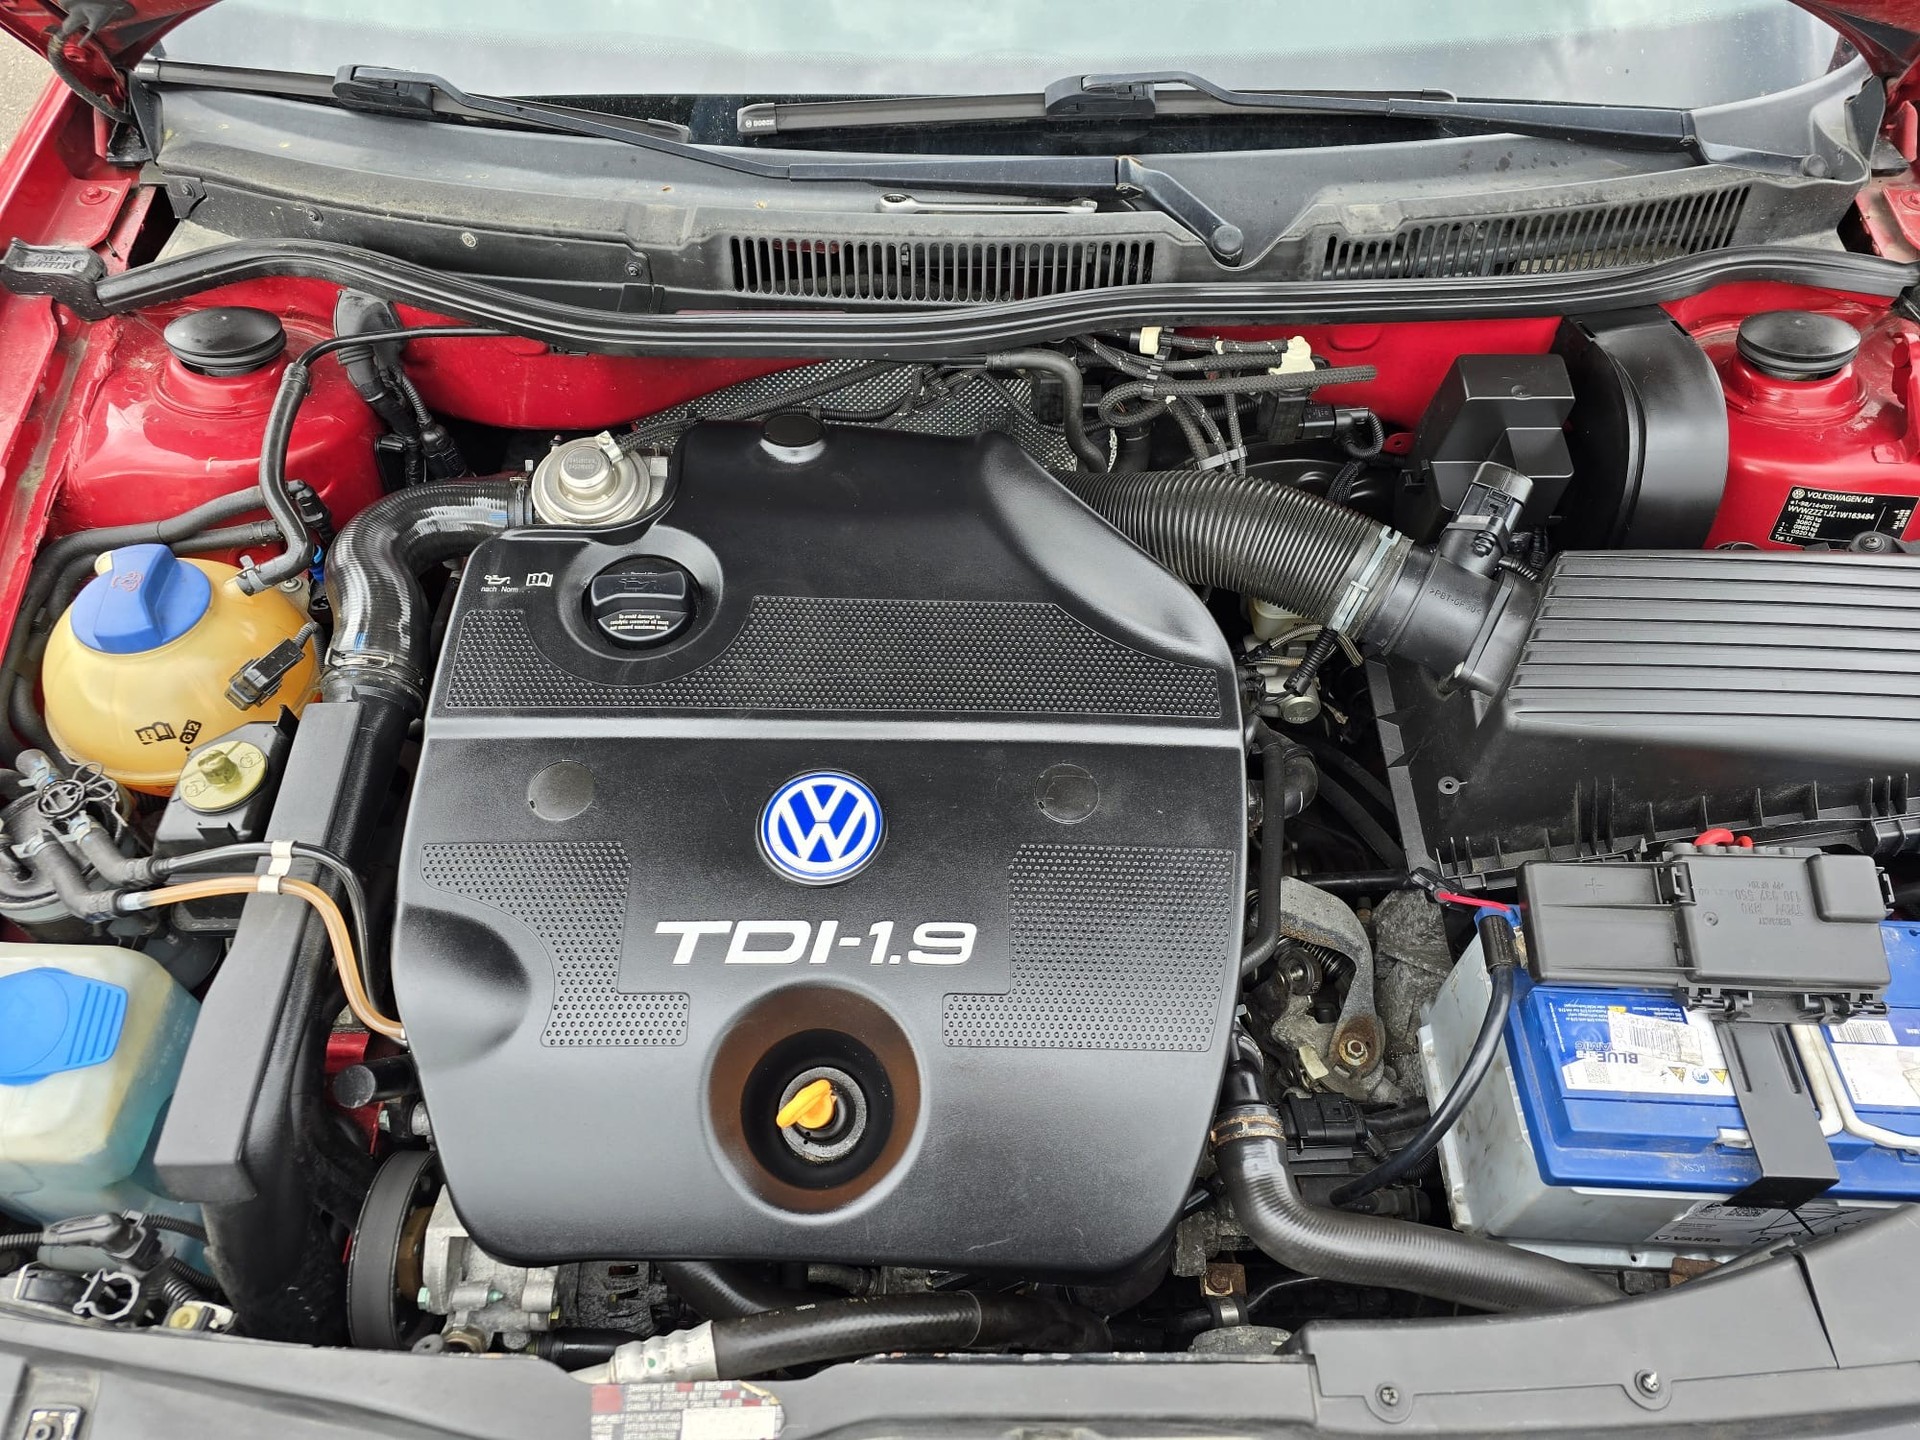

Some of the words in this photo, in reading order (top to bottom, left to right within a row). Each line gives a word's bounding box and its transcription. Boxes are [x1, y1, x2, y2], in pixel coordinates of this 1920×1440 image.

[1807, 491, 1862, 503] VOLKSWAGEN
[1862, 496, 1874, 504] AG
[180, 720, 201, 743] G12
[764, 774, 879, 876] VW
[654, 920, 978, 965] TDI-1.9
[1597, 1051, 1638, 1064] BLUE
